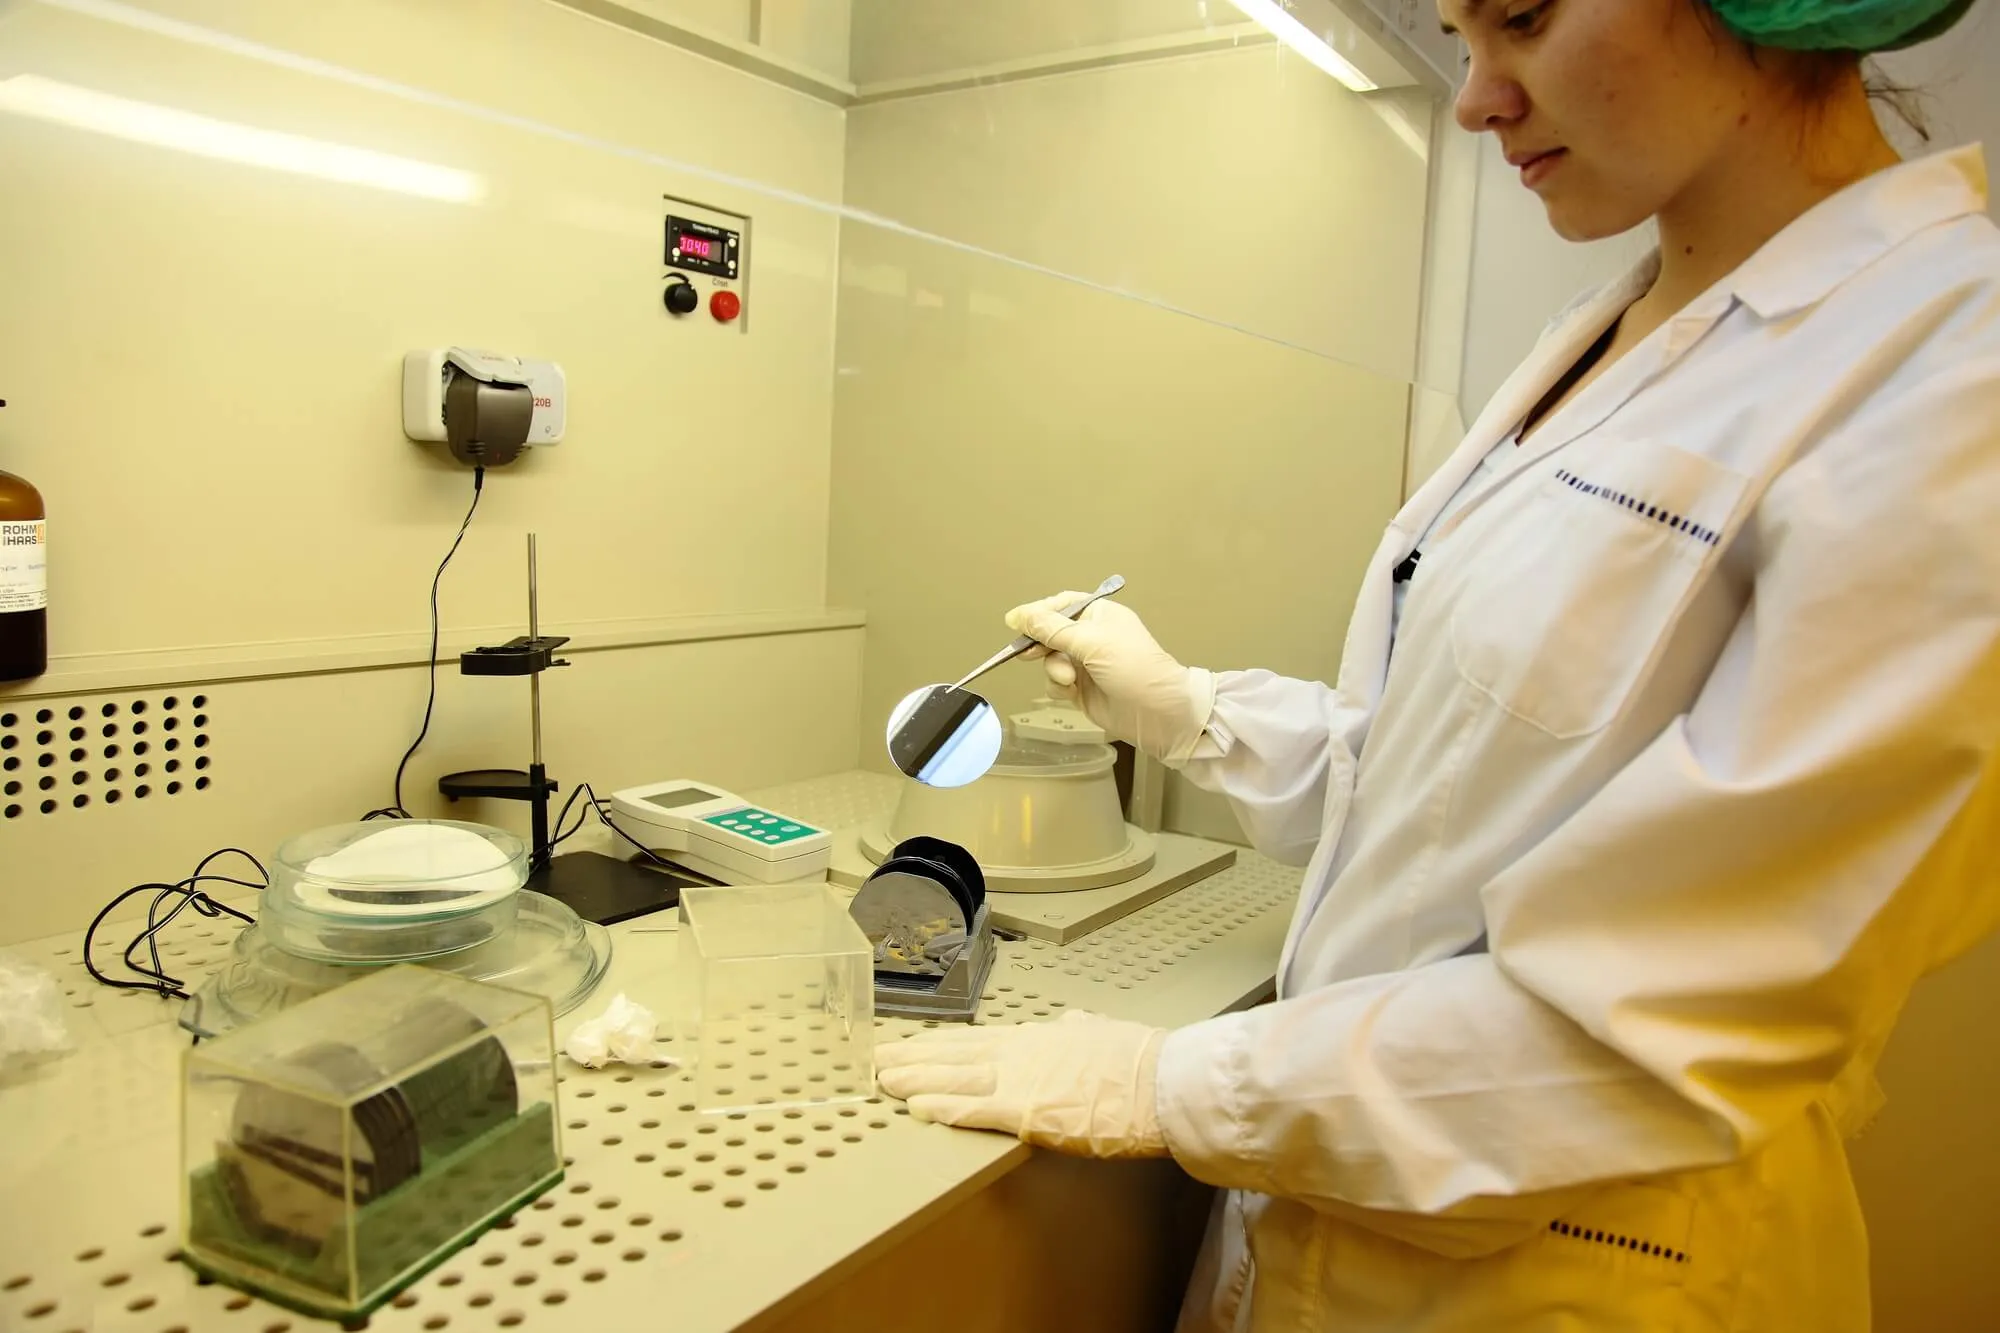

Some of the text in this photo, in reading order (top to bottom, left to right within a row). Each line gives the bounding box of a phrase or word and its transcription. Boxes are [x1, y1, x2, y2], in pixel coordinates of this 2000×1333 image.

[533, 398, 551, 408] 20B
[2, 525, 37, 535] ROHM
[7, 536, 37, 546] HAAS
